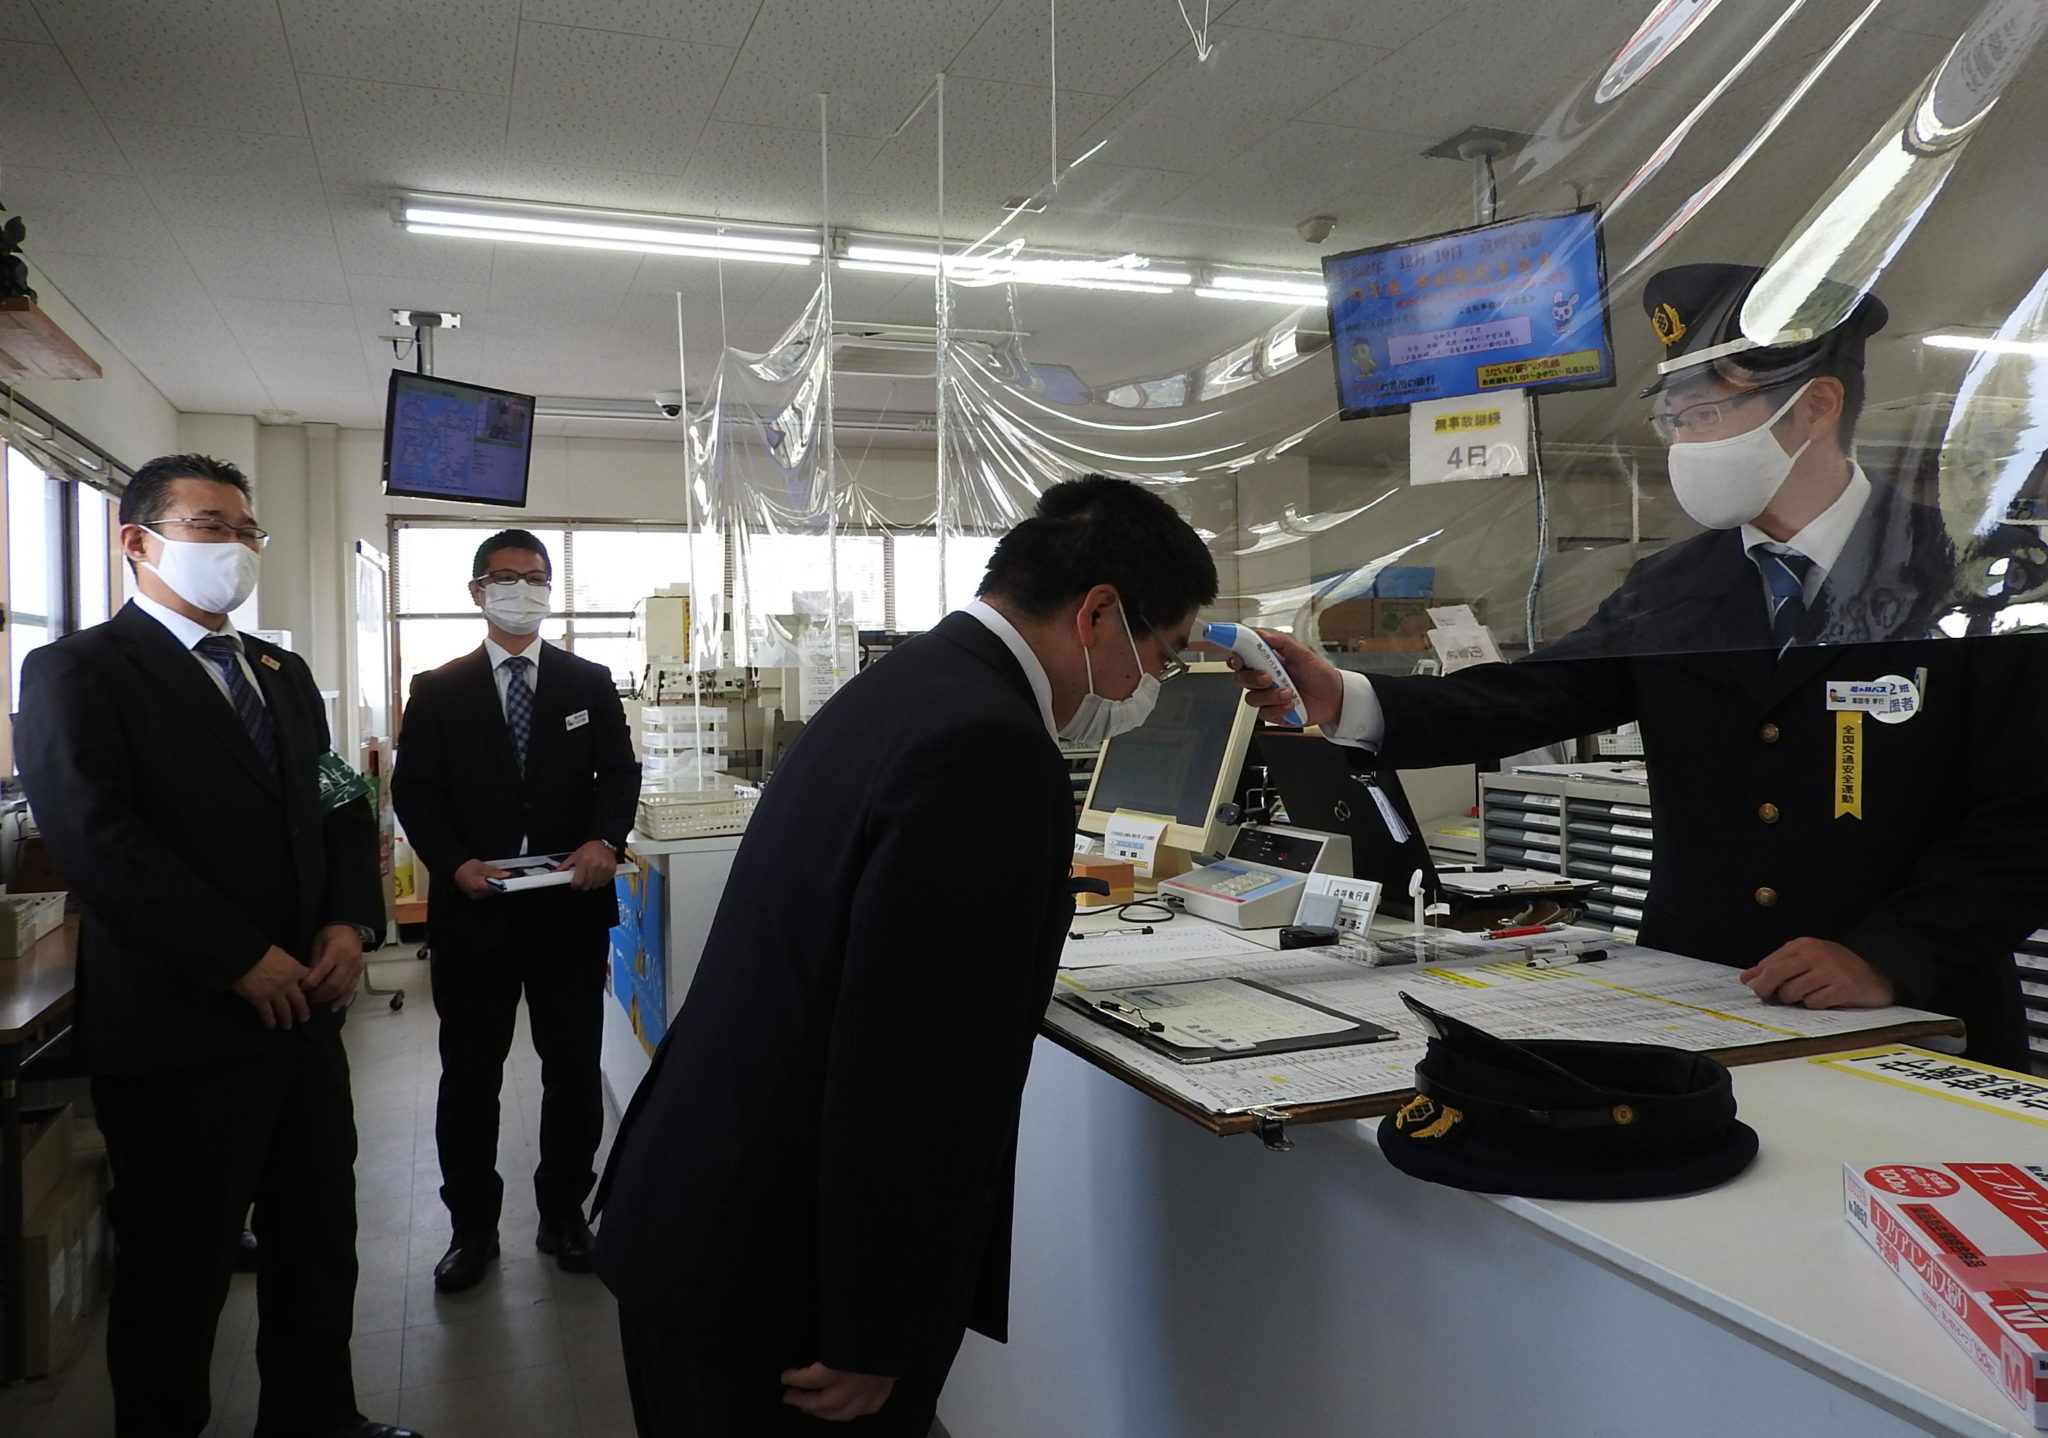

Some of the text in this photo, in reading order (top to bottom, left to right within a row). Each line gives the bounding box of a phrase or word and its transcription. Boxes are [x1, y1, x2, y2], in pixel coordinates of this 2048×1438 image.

[1434, 411, 1501, 432] 無事故継続
[1447, 445, 1487, 469] 4日
[1841, 725, 1855, 804] 全国交通安全運動
[2004, 1351, 2022, 1401] M
